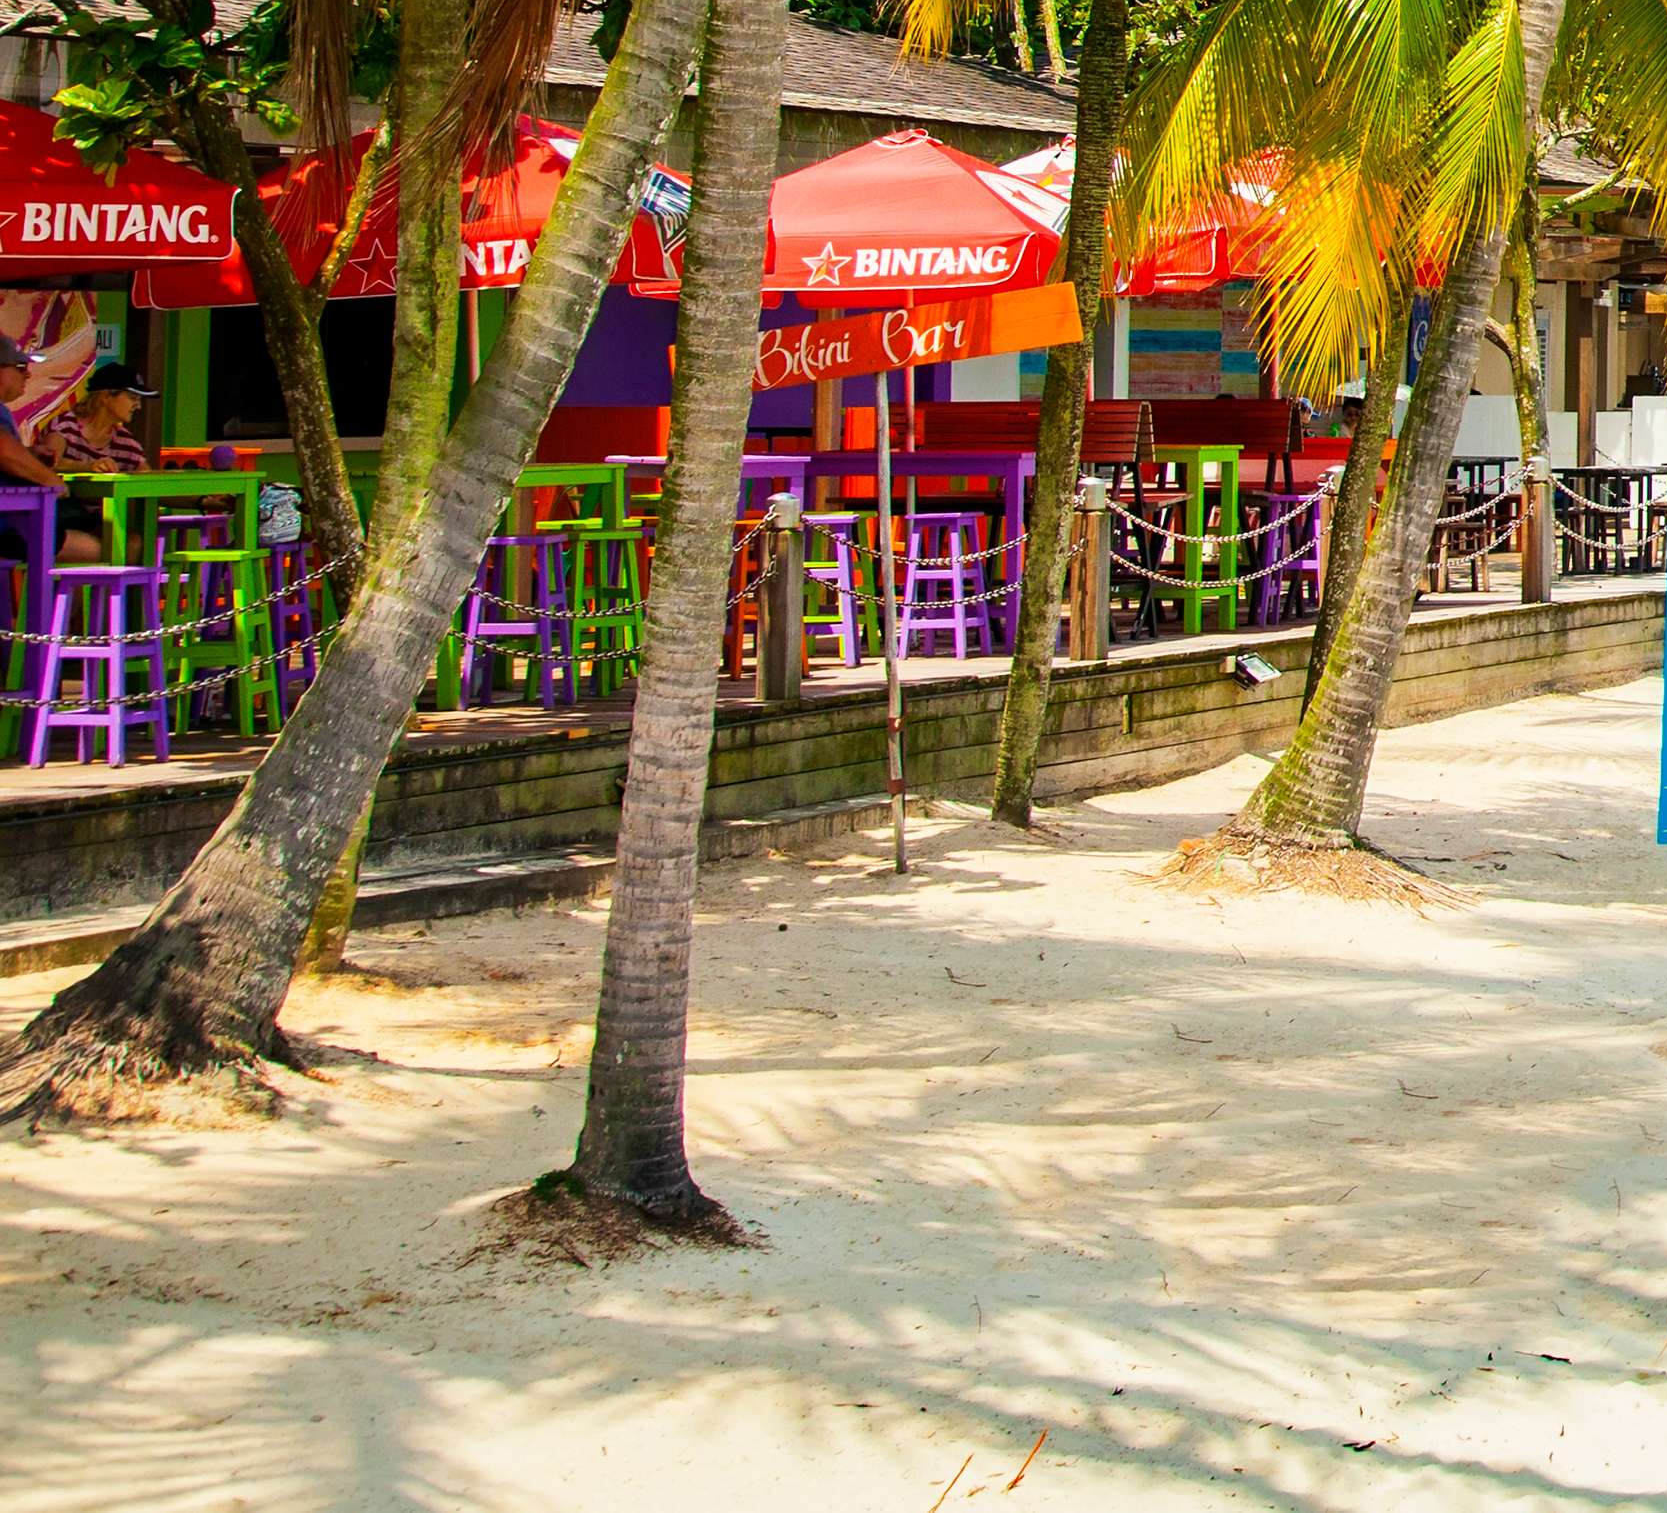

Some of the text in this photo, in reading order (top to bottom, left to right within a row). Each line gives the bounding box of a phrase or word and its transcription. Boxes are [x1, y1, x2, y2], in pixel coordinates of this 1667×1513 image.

[21, 202, 210, 244] BINTANG
[853, 246, 1009, 277] BINTANG
[752, 308, 966, 391] Bikini Bar
